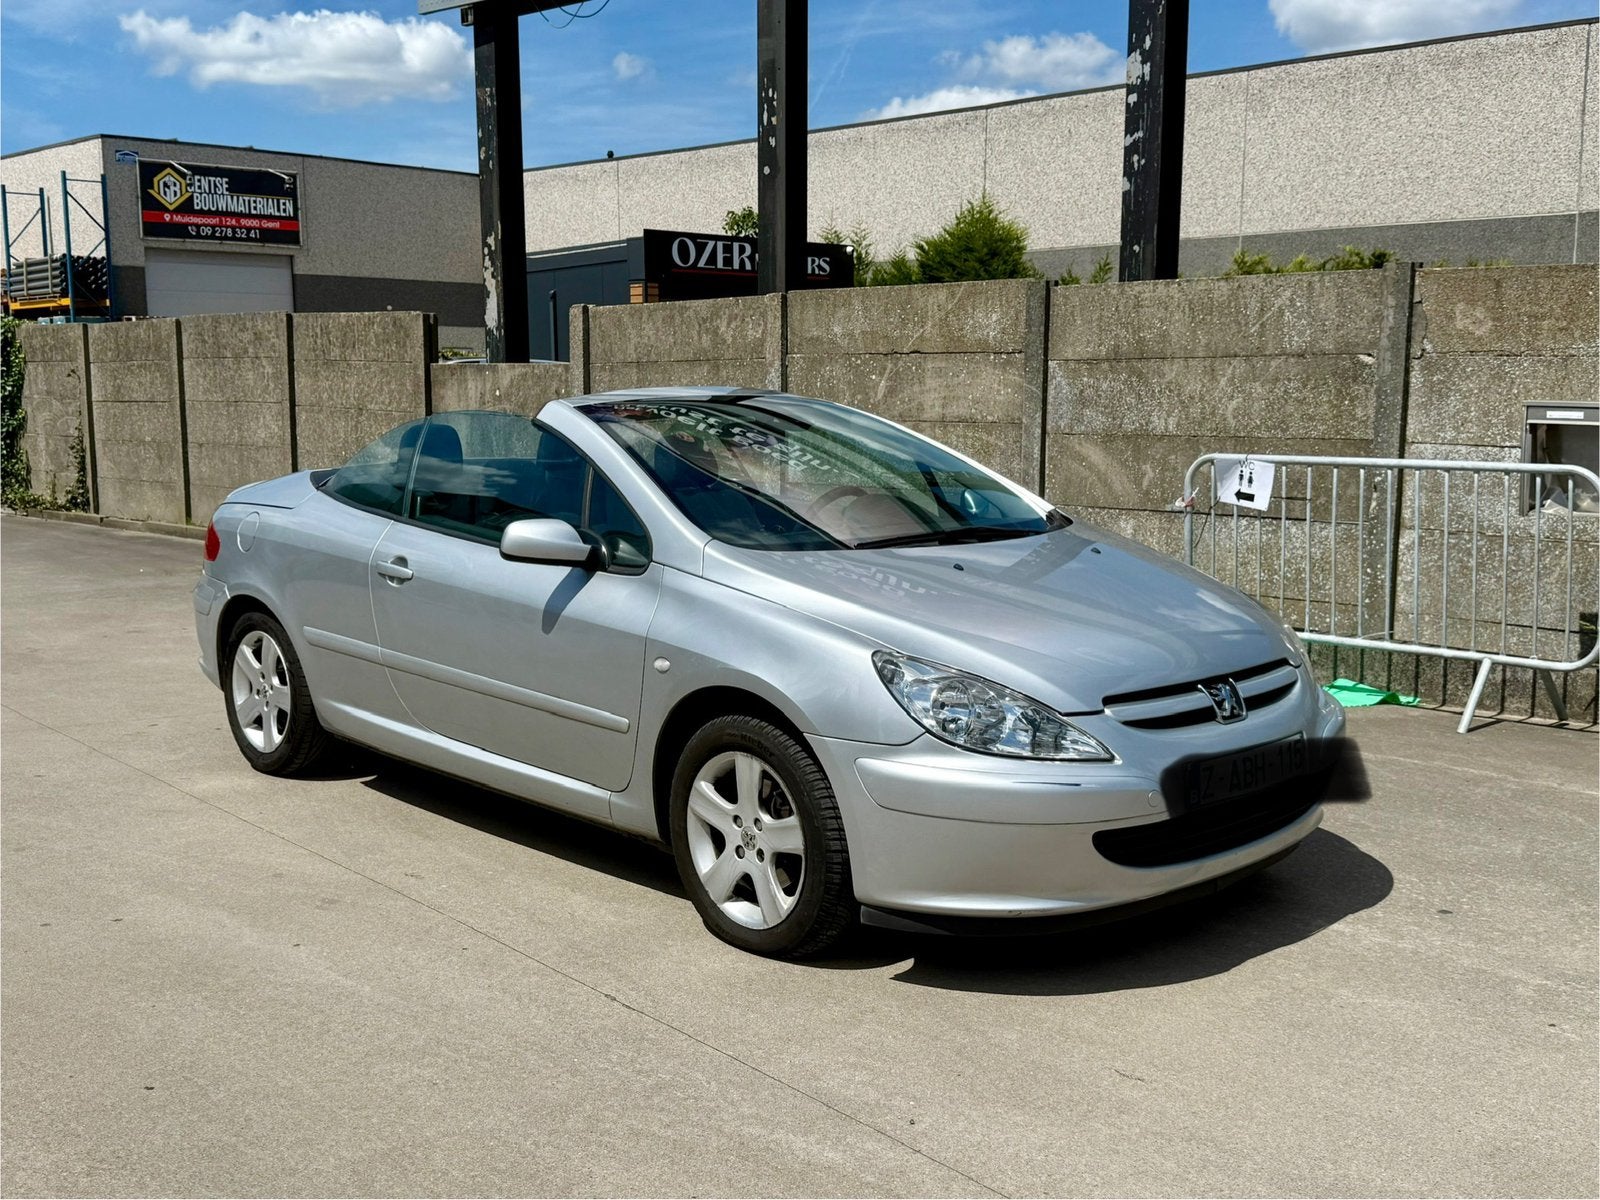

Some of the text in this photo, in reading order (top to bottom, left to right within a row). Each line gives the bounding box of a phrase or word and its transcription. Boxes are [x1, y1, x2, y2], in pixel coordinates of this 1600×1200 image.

[193, 193, 293, 217] BOUWMATERIALEN
[173, 214, 219, 225] Muidepoort
[240, 219, 260, 227] 9000
[261, 220, 280, 228] Gent
[200, 226, 260, 239] 09 278 32 41
[671, 237, 830, 275] OZER RS
[1239, 460, 1255, 471] WC
